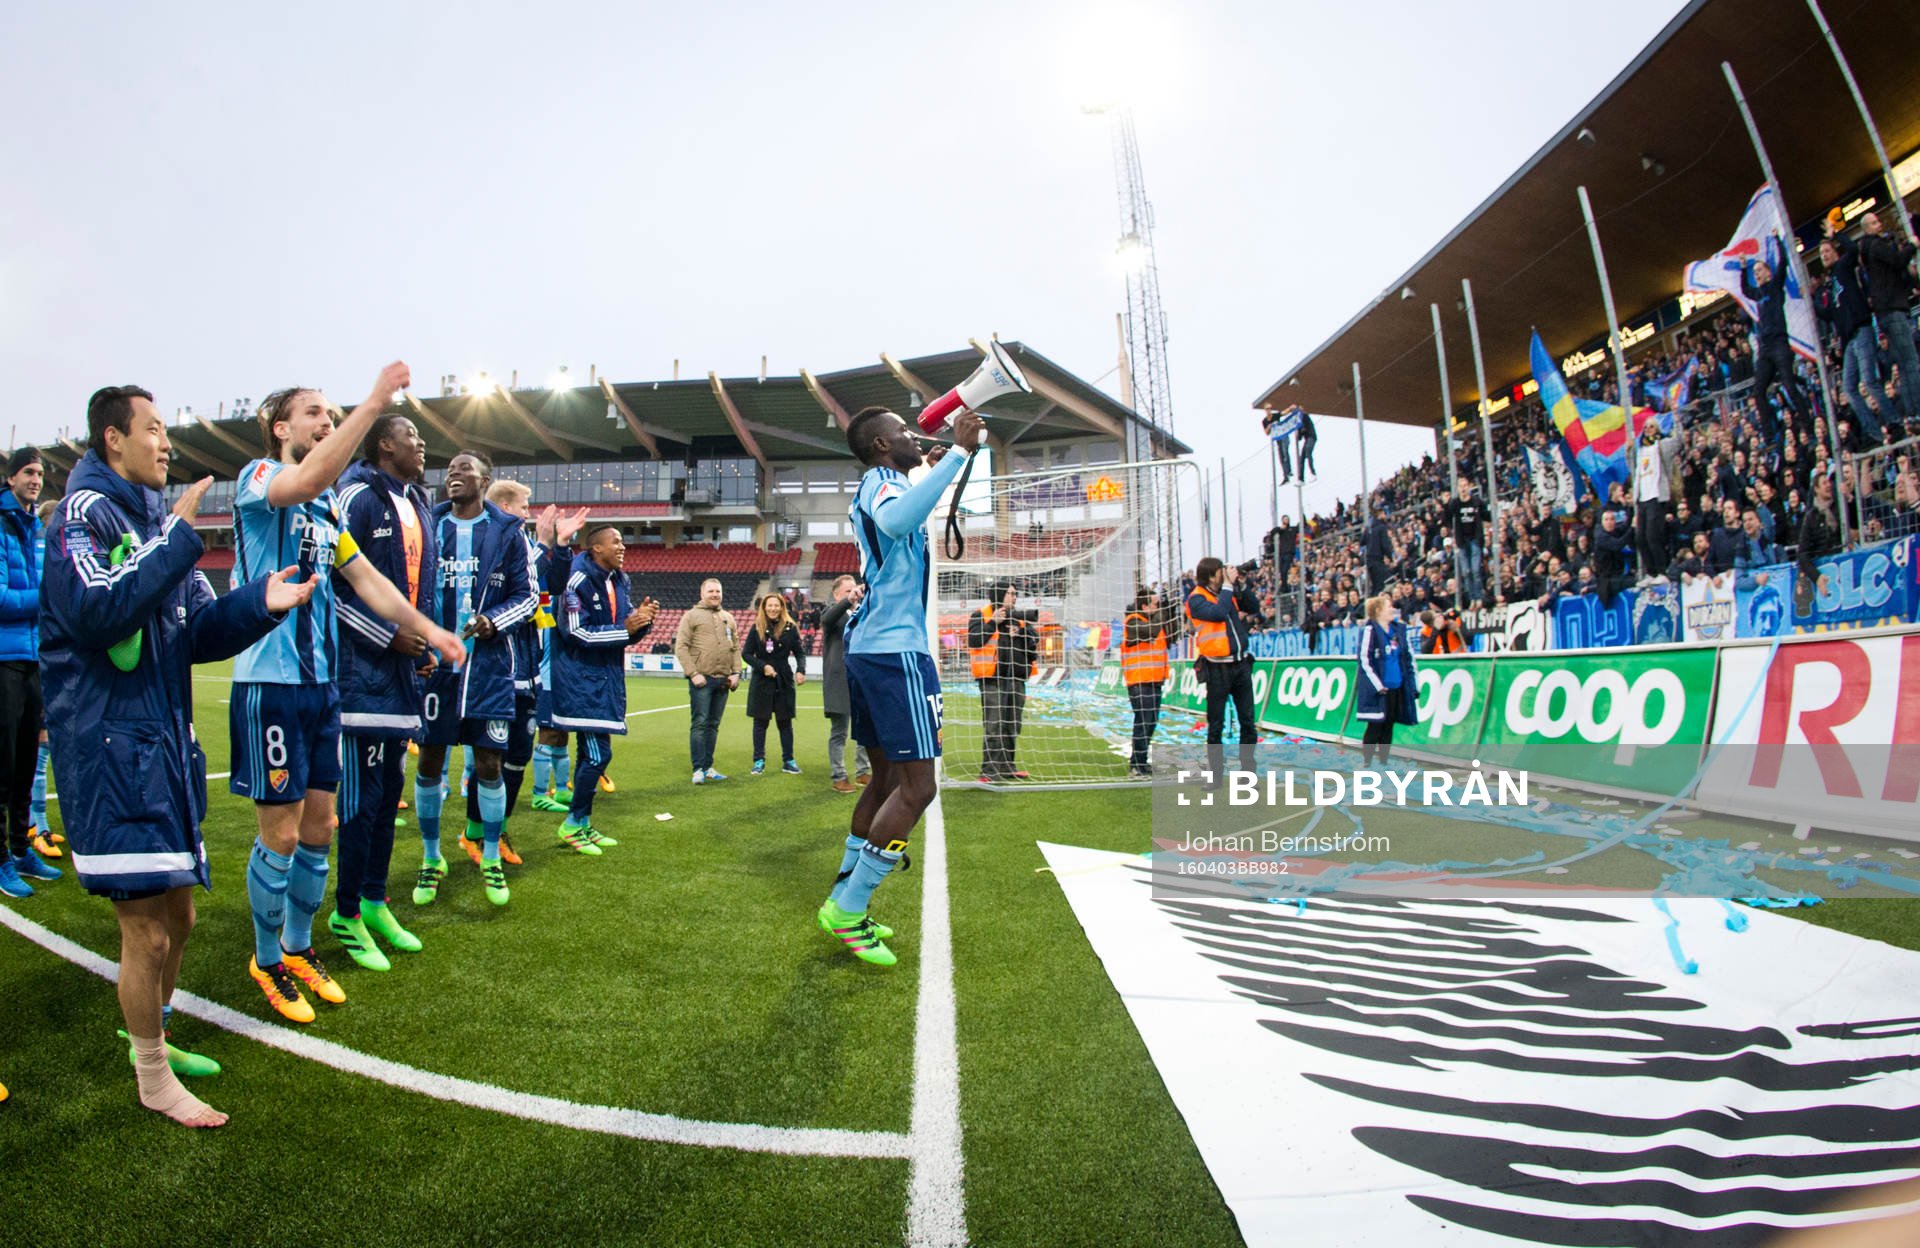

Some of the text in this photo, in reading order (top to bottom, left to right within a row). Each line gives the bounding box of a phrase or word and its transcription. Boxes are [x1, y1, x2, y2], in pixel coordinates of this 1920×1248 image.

[1277, 666, 1348, 721] coop
[1504, 667, 1687, 767] coop
[266, 725, 288, 767] 8
[367, 742, 385, 767] 24
